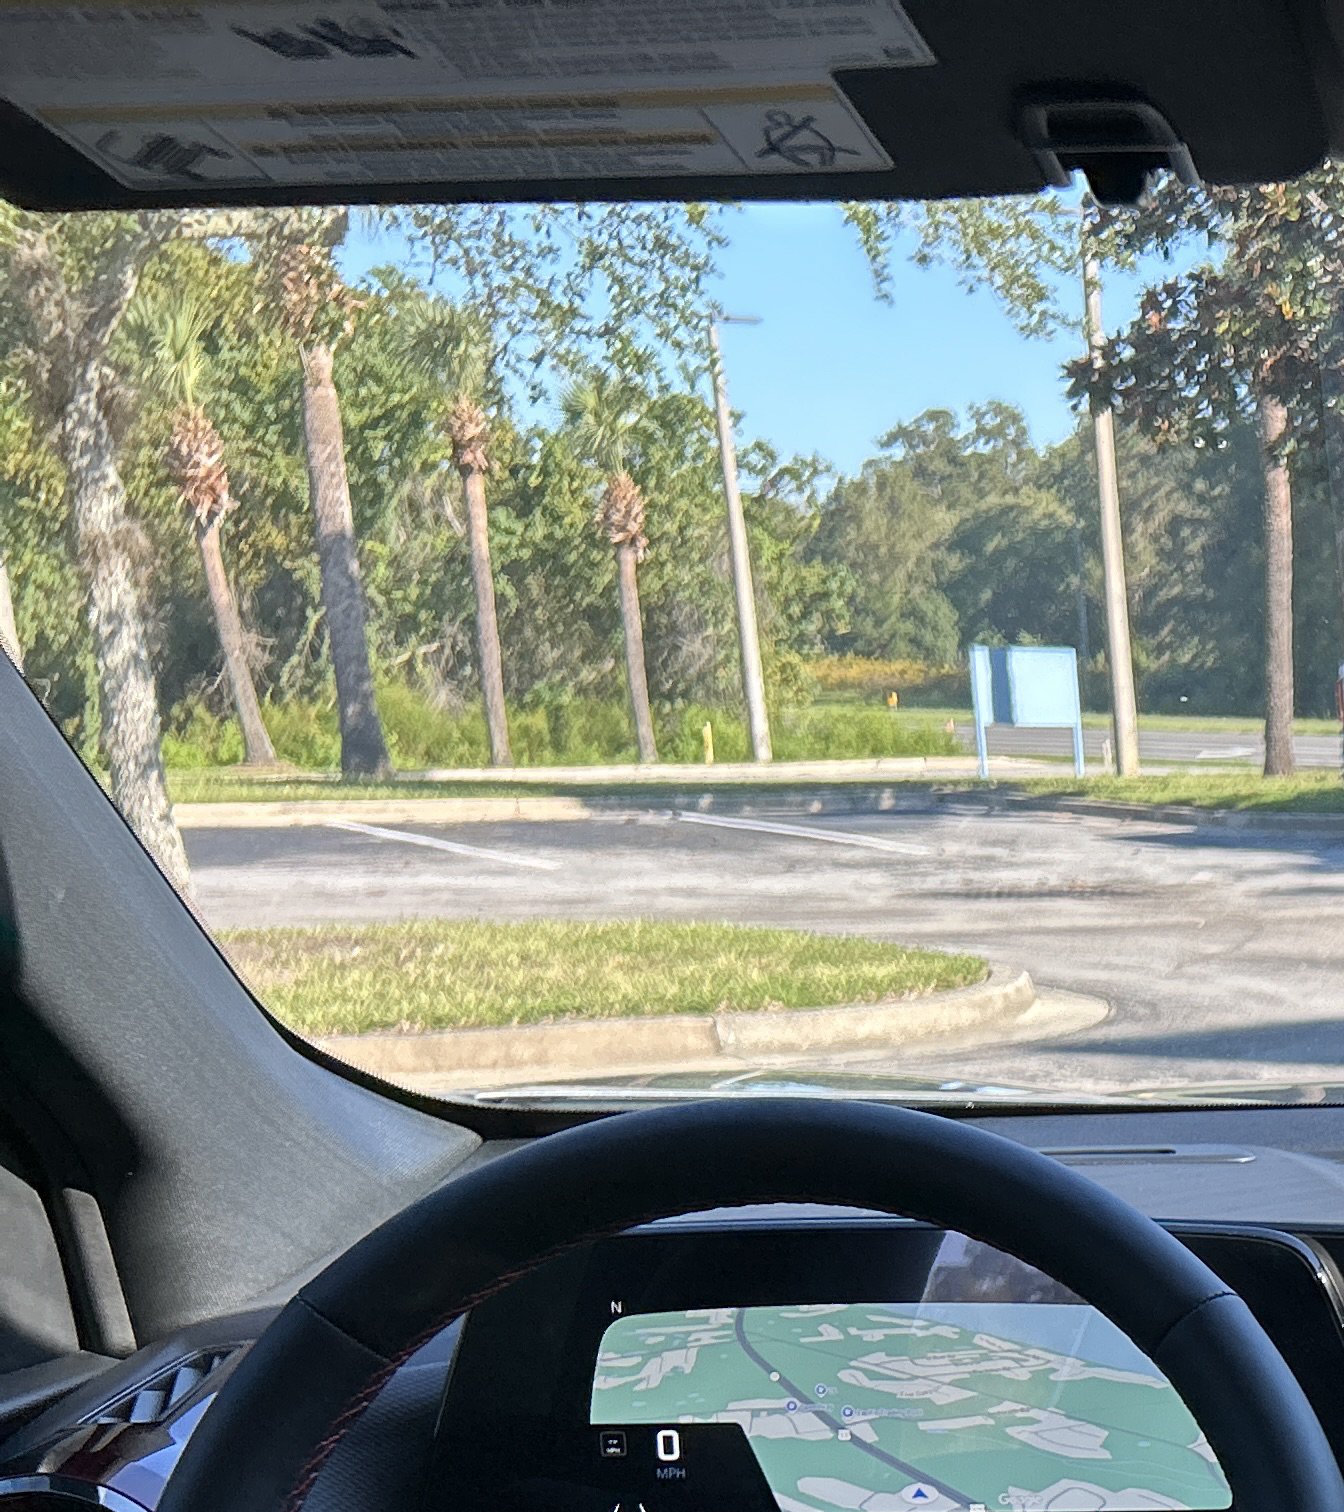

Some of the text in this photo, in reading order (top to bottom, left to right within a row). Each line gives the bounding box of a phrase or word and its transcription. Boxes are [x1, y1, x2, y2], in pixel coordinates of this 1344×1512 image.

[611, 1301, 622, 1314] N
[656, 1429, 680, 1462] 0
[656, 1467, 686, 1479] MPH
